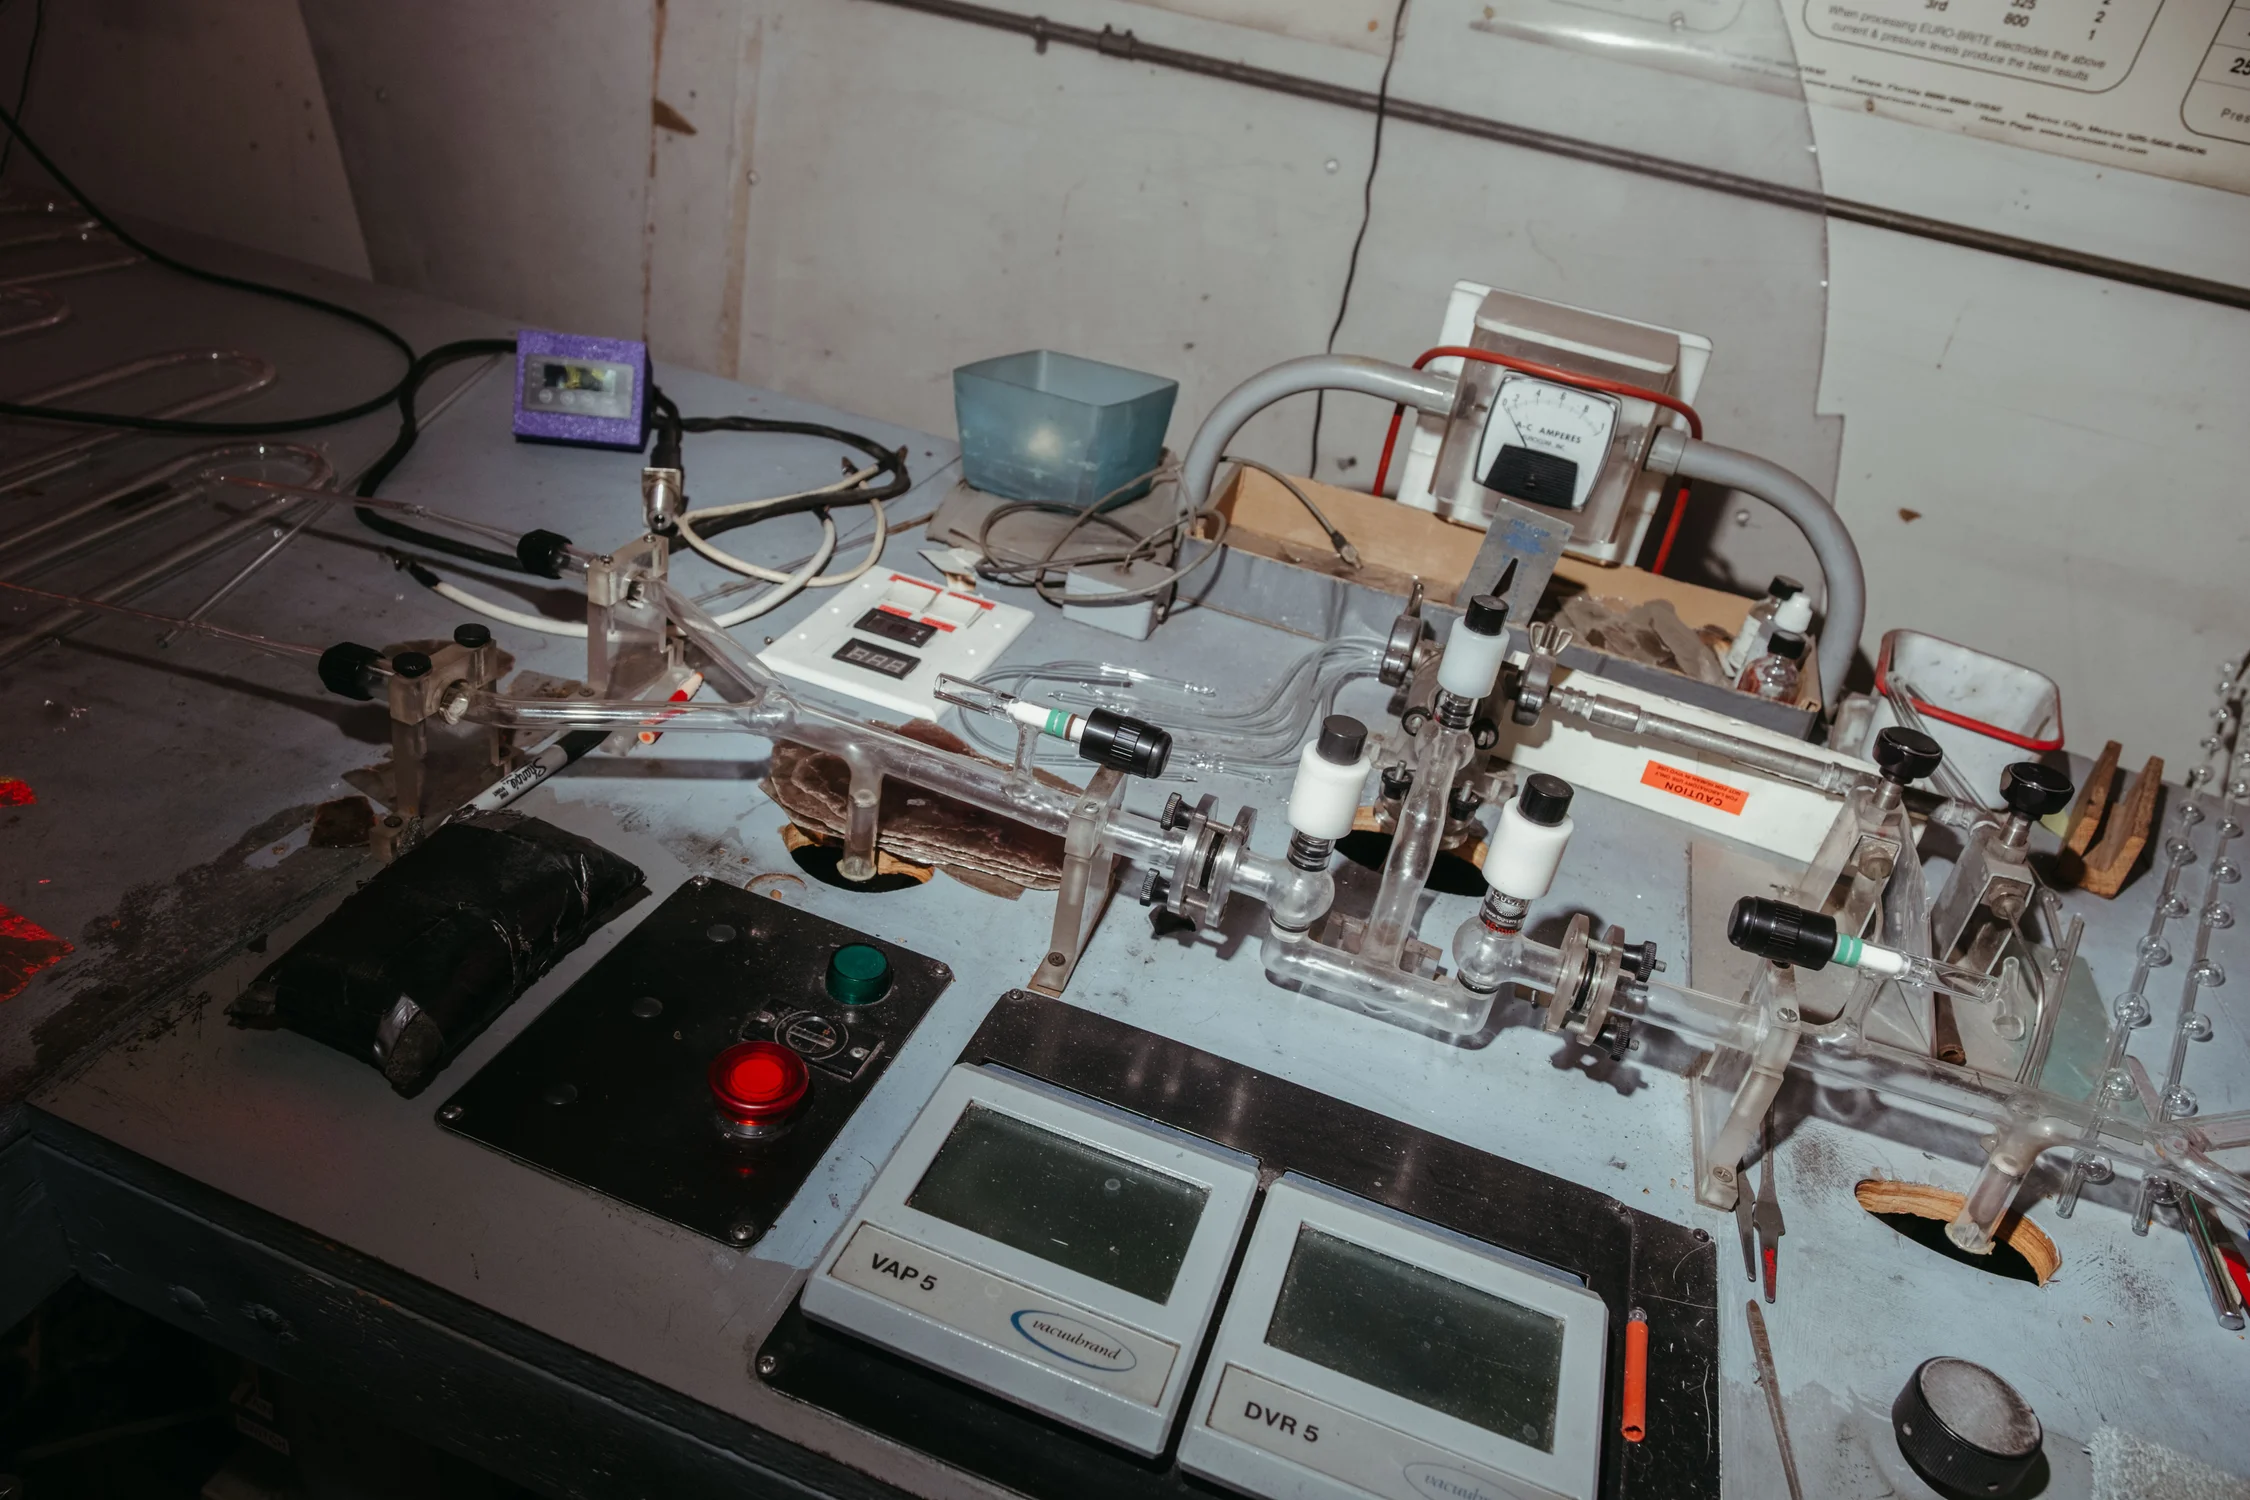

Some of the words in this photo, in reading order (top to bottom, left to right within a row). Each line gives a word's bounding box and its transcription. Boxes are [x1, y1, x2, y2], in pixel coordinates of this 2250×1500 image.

[2094, 10, 2106, 23] 2
[1828, 4, 1858, 18] When
[1860, 13, 1917, 33] processing
[1994, 39, 2048, 58] electrodes
[2052, 49, 2070, 62] the
[2072, 54, 2106, 69] above
[1831, 22, 1869, 37] current
[1870, 28, 1878, 39] &
[1880, 31, 1926, 49] pressure
[1929, 42, 1959, 55] levels
[1961, 47, 2005, 65] produce
[2007, 56, 2025, 68] the
[2027, 60, 2051, 74] best
[2053, 66, 2089, 82] results
[1539, 427, 1582, 444] AMPERES
[1657, 764, 1670, 772] USE
[1671, 769, 1684, 779] VIVO
[1655, 770, 1671, 780] ONLY
[1672, 776, 1684, 784] USE
[1692, 776, 1714, 787] HUMAN
[1685, 781, 1724, 797] LABORATORY
[1715, 783, 1728, 791] FOR
[1728, 788, 1742, 796] NOT
[1665, 782, 1722, 806] CAUTION
[1725, 794, 1739, 802] FOR
[870, 1252, 919, 1281] VAP
[919, 1275, 938, 1291] 5
[1032, 1318, 1123, 1361] vacuubrand
[1243, 1400, 1298, 1436] DVR
[1303, 1425, 1320, 1444] 5
